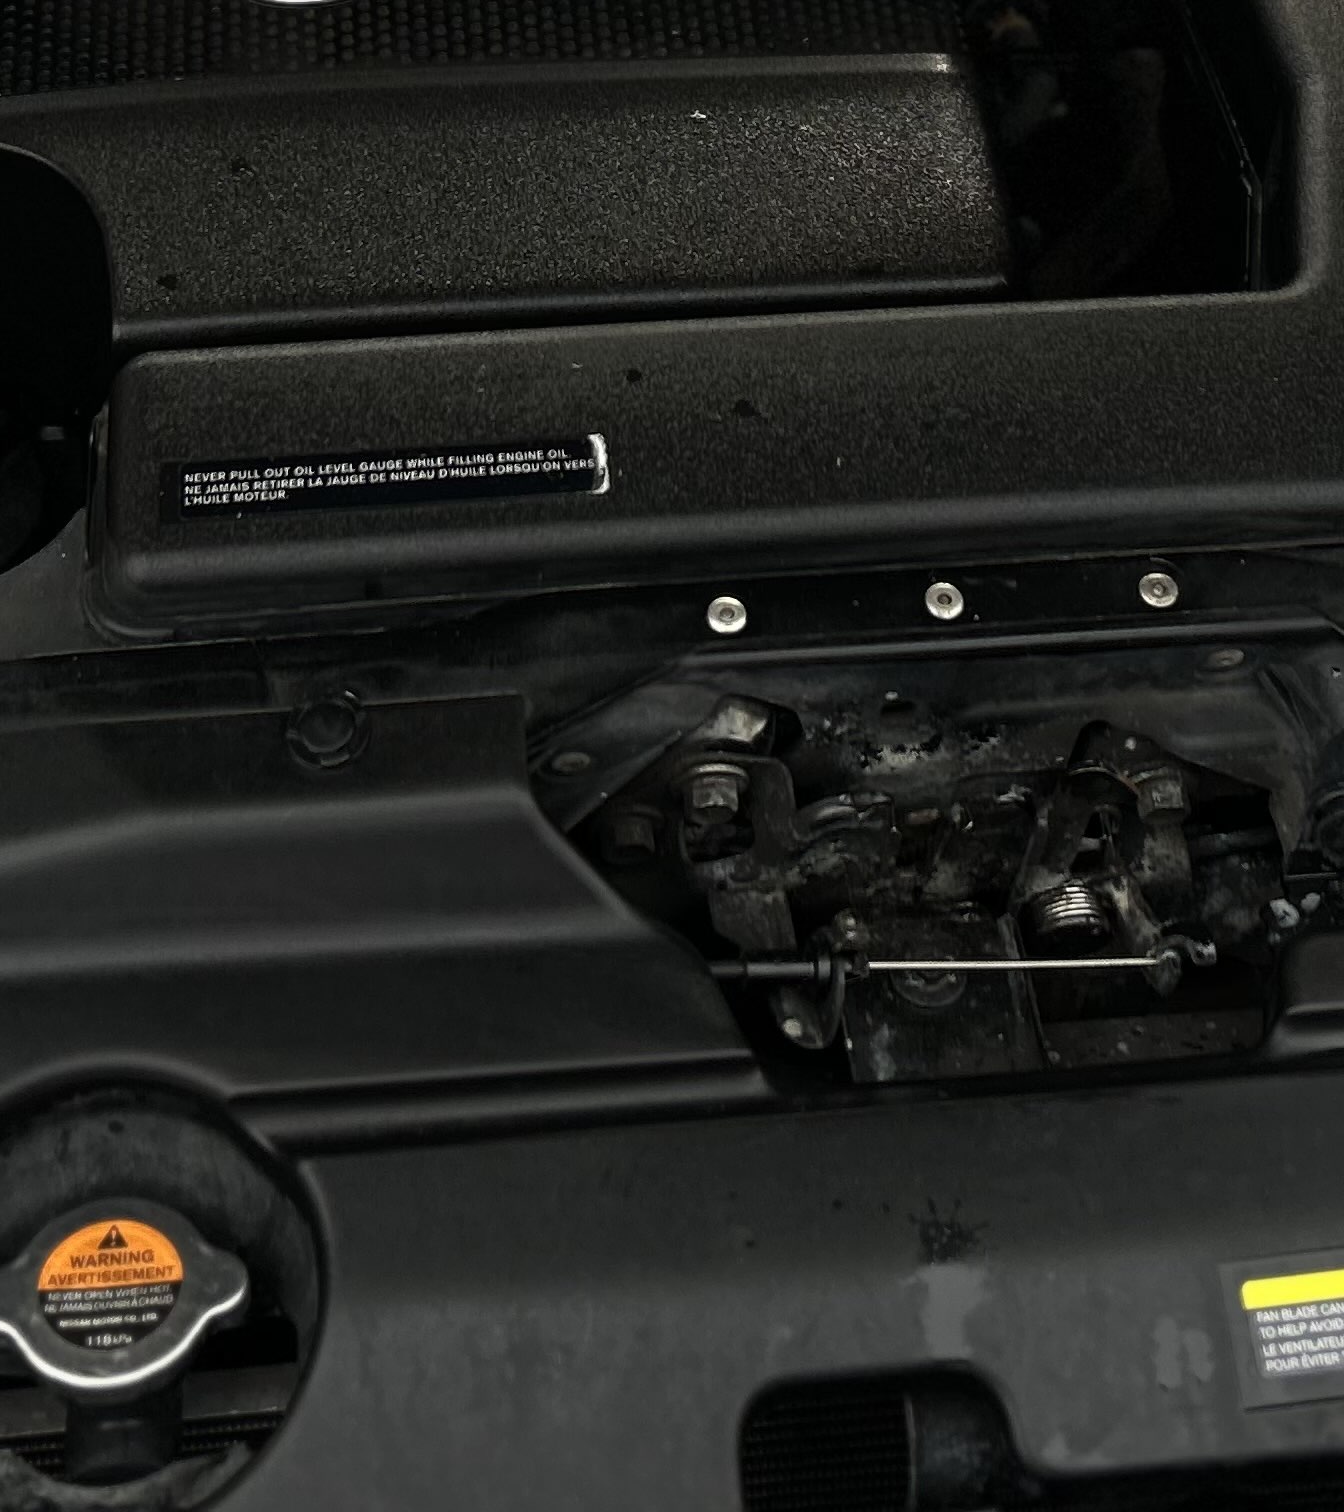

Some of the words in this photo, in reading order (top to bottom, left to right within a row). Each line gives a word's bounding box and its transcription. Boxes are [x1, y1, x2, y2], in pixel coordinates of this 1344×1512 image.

[184, 472, 226, 483] NEVER
[230, 469, 260, 481] PULL
[264, 467, 291, 478] OUT
[293, 464, 315, 476] OIL
[319, 462, 356, 474] LEVEL
[359, 459, 403, 472] GAUGE
[407, 456, 444, 469] WHILE
[448, 453, 495, 466] FILLING
[498, 449, 545, 463] ENGINE
[184, 484, 202, 495] NE
[205, 481, 250, 494] JAMAIS
[253, 478, 305, 491] RETIRER
[308, 476, 323, 488] LA
[326, 473, 366, 486] JAUGE
[370, 472, 387, 483] DE
[390, 468, 435, 481] NIVEAU
[438, 465, 486, 479] D'HUILE
[490, 461, 561, 476] LORSQU'ON
[184, 493, 230, 506] L'HUILE
[69, 1248, 155, 1269] WARNING
[47, 1265, 175, 1286] AVERTISSEMENT
[48, 1290, 82, 1302] NEVER
[84, 1289, 114, 1300] OPEN
[115, 1285, 148, 1299] WHEN
[59, 1301, 93, 1313] JAMAIS
[139, 1294, 174, 1306] CHAUD
[1256, 1310, 1280, 1323] FAN
[1281, 1305, 1318, 1321] BLADE
[1259, 1325, 1276, 1339] TO
[1277, 1323, 1308, 1336] HELP
[1309, 1318, 1344, 1333] AVOID
[1262, 1343, 1277, 1357] LE
[1265, 1356, 1299, 1372] POUR
[1301, 1351, 1340, 1368] ÉVITER
